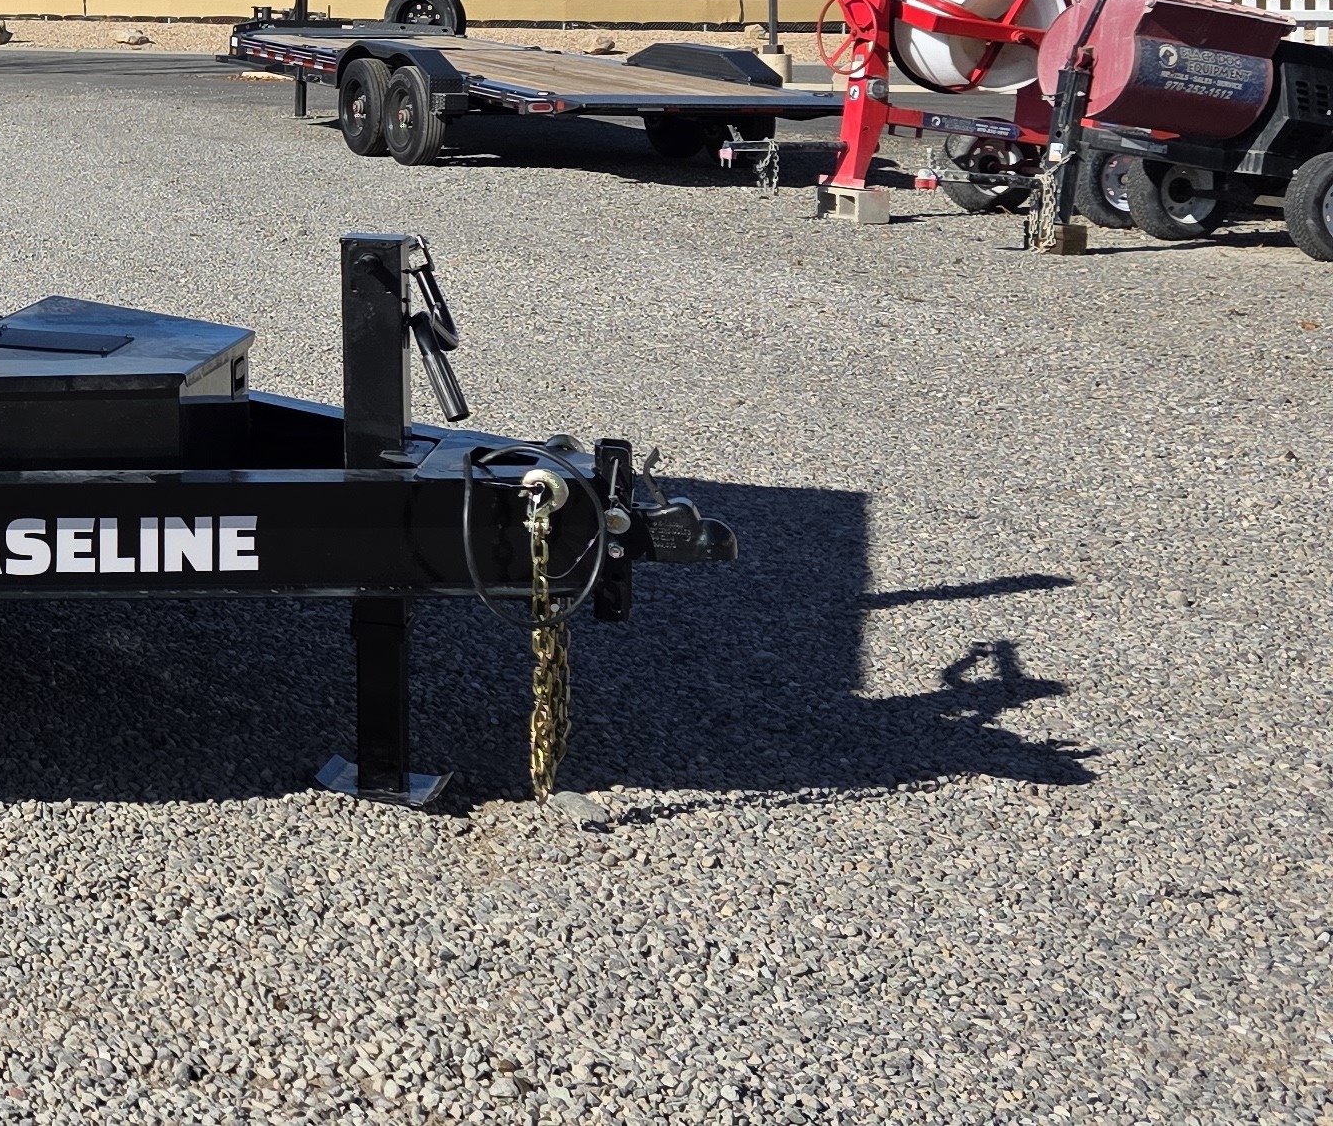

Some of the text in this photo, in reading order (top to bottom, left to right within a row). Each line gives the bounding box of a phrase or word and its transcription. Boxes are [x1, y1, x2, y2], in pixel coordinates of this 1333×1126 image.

[1180, 47, 1216, 63] BLACK
[1186, 61, 1252, 82] EQUIPMENT
[1164, 81, 1234, 100] 970-252-1512
